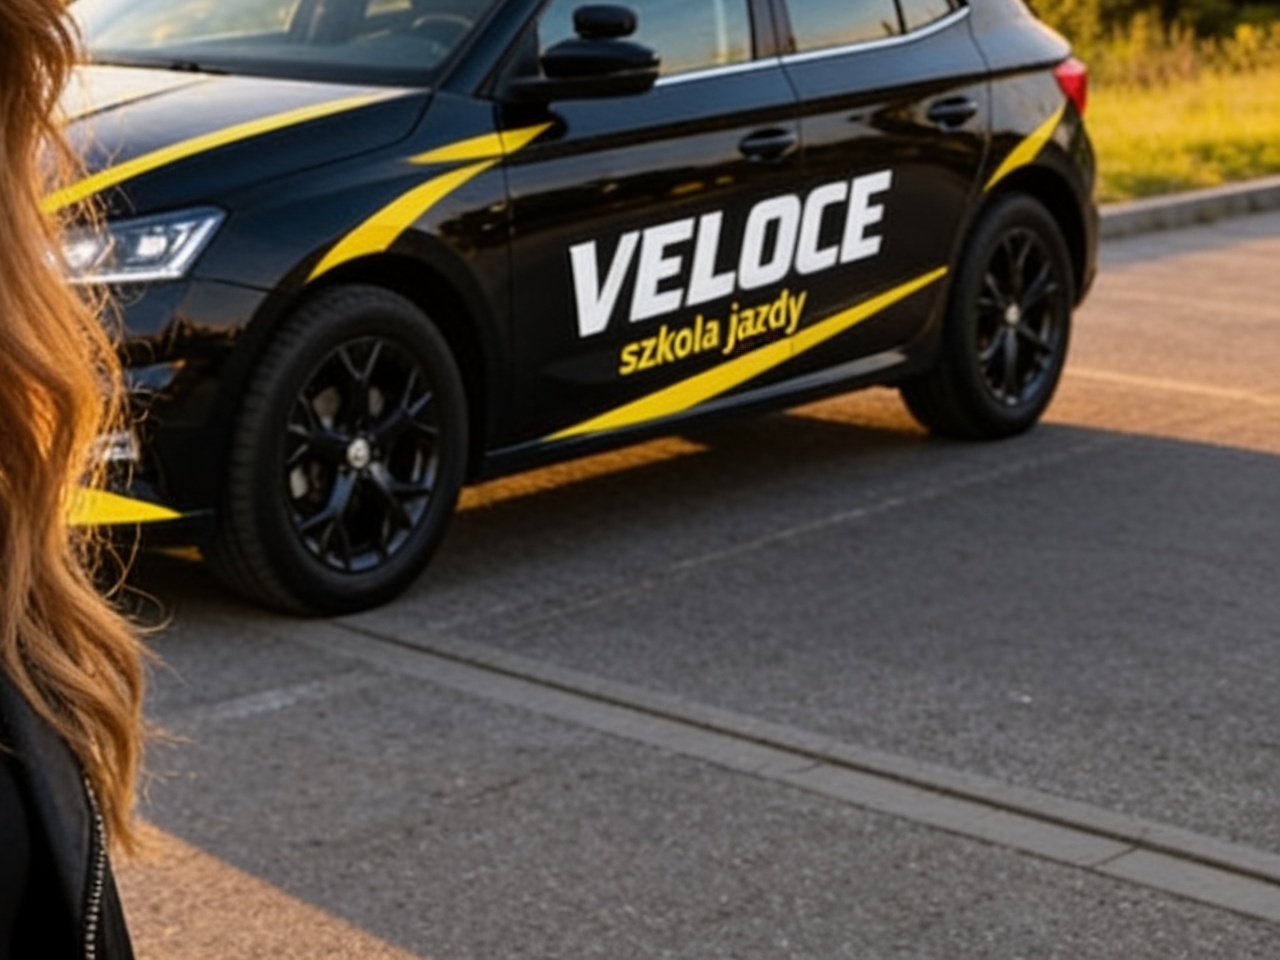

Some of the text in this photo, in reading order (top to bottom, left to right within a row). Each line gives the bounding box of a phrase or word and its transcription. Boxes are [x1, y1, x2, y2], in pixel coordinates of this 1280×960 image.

[569, 169, 893, 338] VELOCE
[619, 288, 807, 375] szkola jazdy
